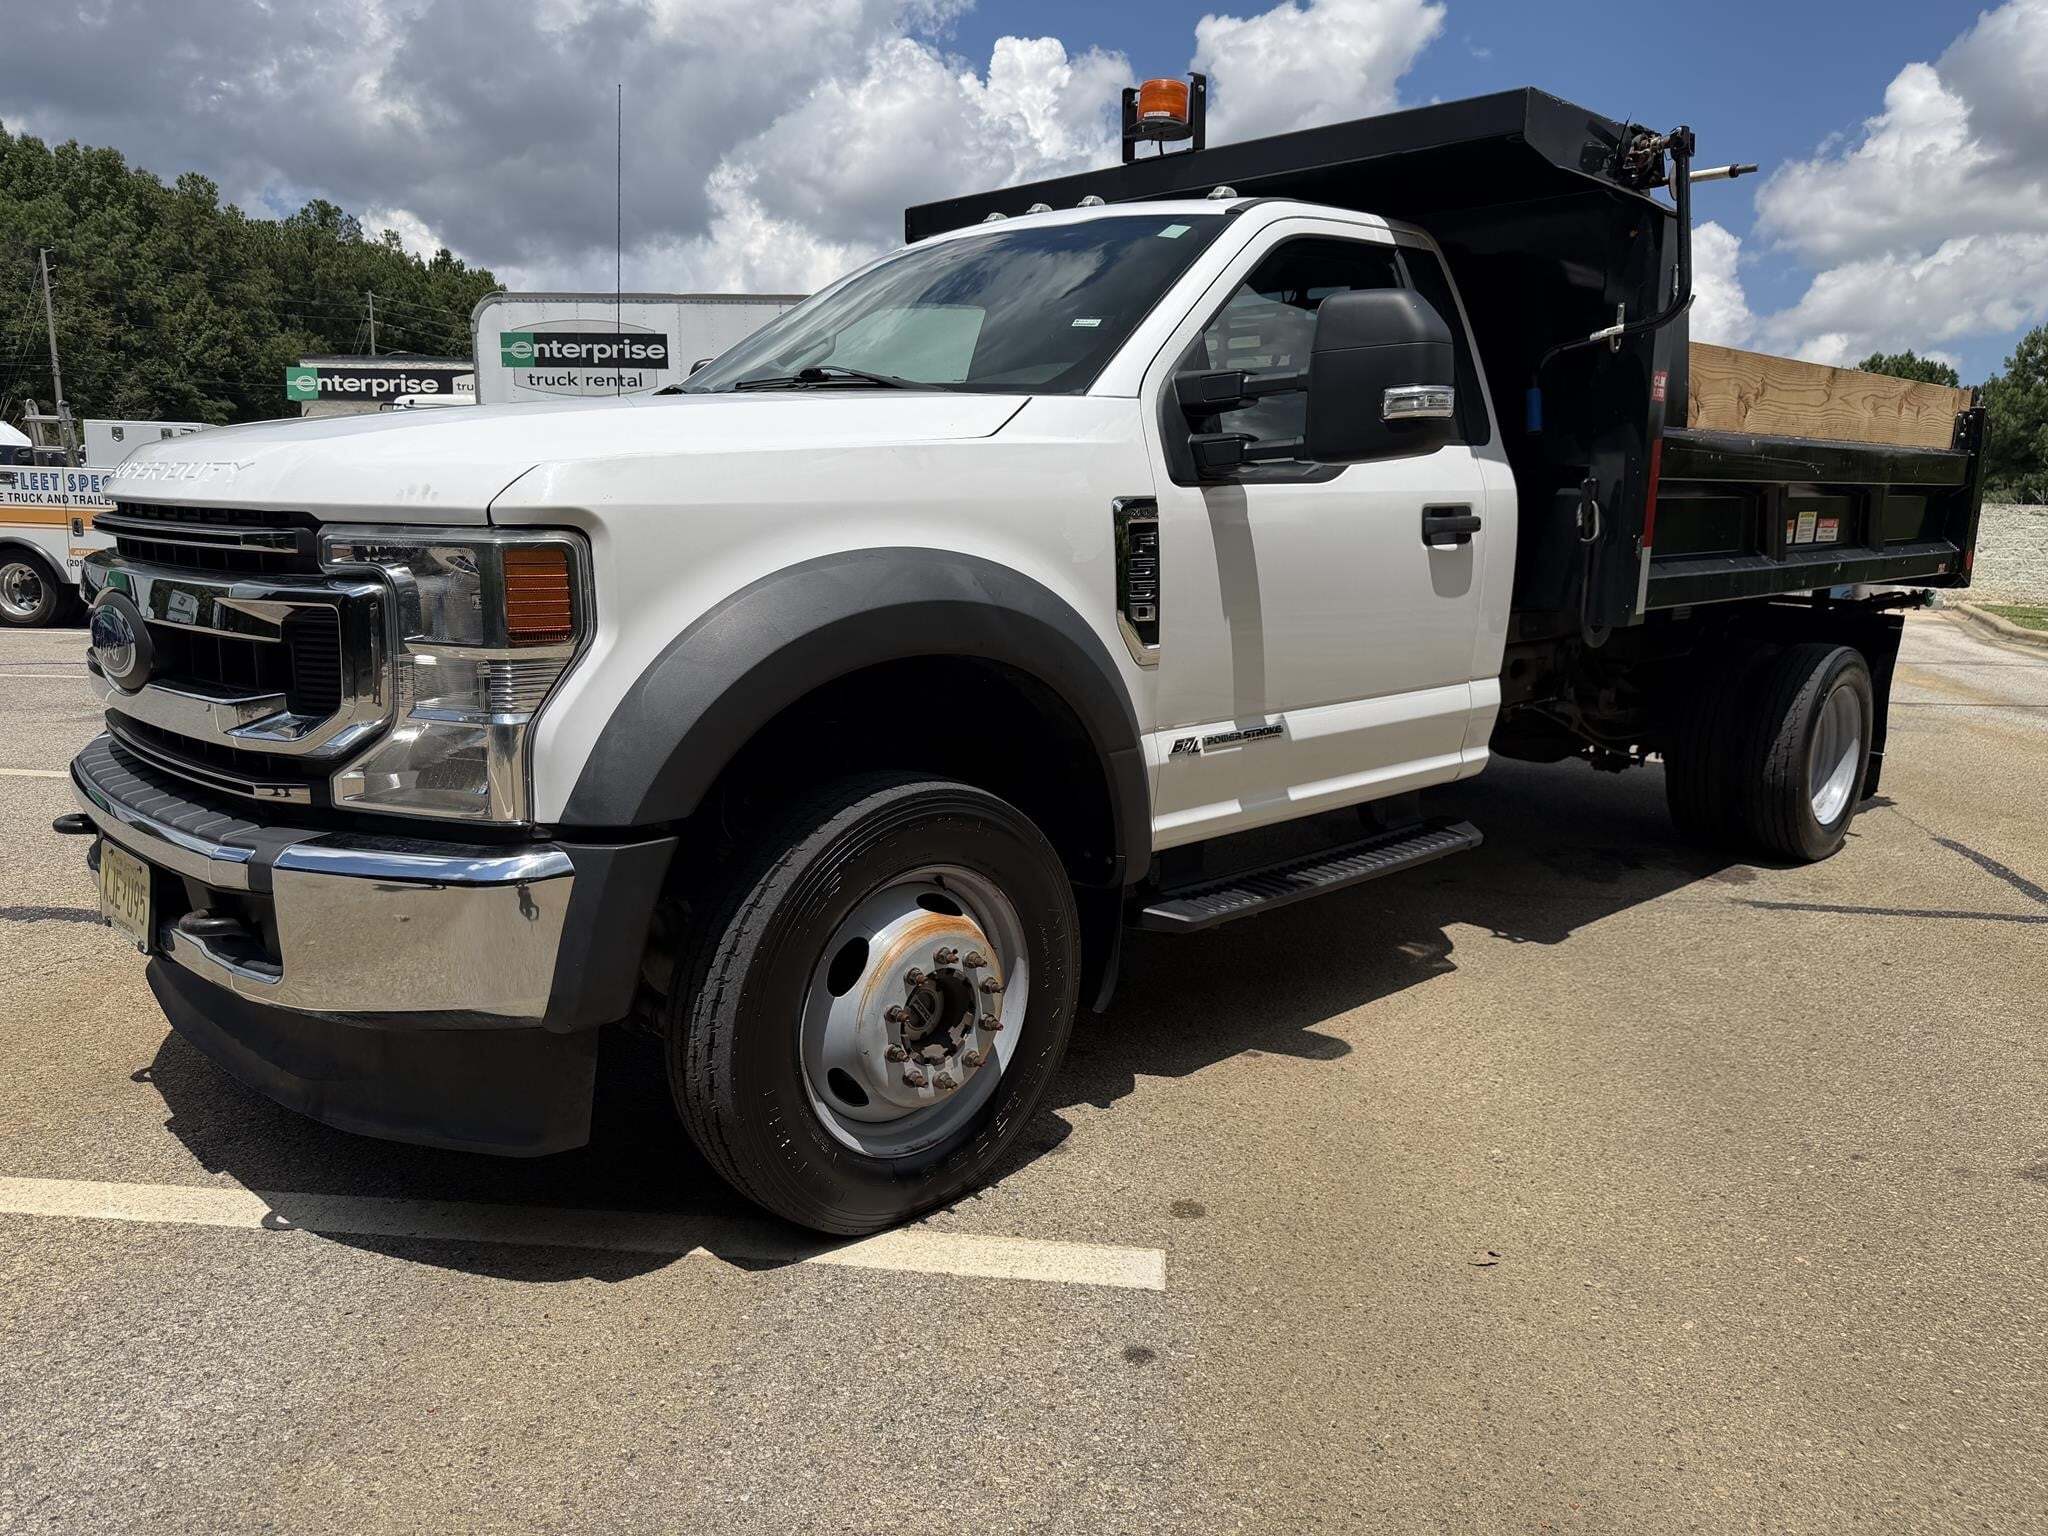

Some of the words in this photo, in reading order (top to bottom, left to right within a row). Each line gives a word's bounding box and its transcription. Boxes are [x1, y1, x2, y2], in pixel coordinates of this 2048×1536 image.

[510, 338, 666, 363] enterprise
[294, 373, 440, 398] enterprise
[527, 371, 578, 386] truck
[585, 372, 643, 388] rental
[11, 472, 59, 491] FLEET
[7, 493, 43, 503] TRUCK
[47, 494, 69, 504] AND
[1206, 731, 1241, 746] POWER
[1243, 724, 1285, 740] STROKE
